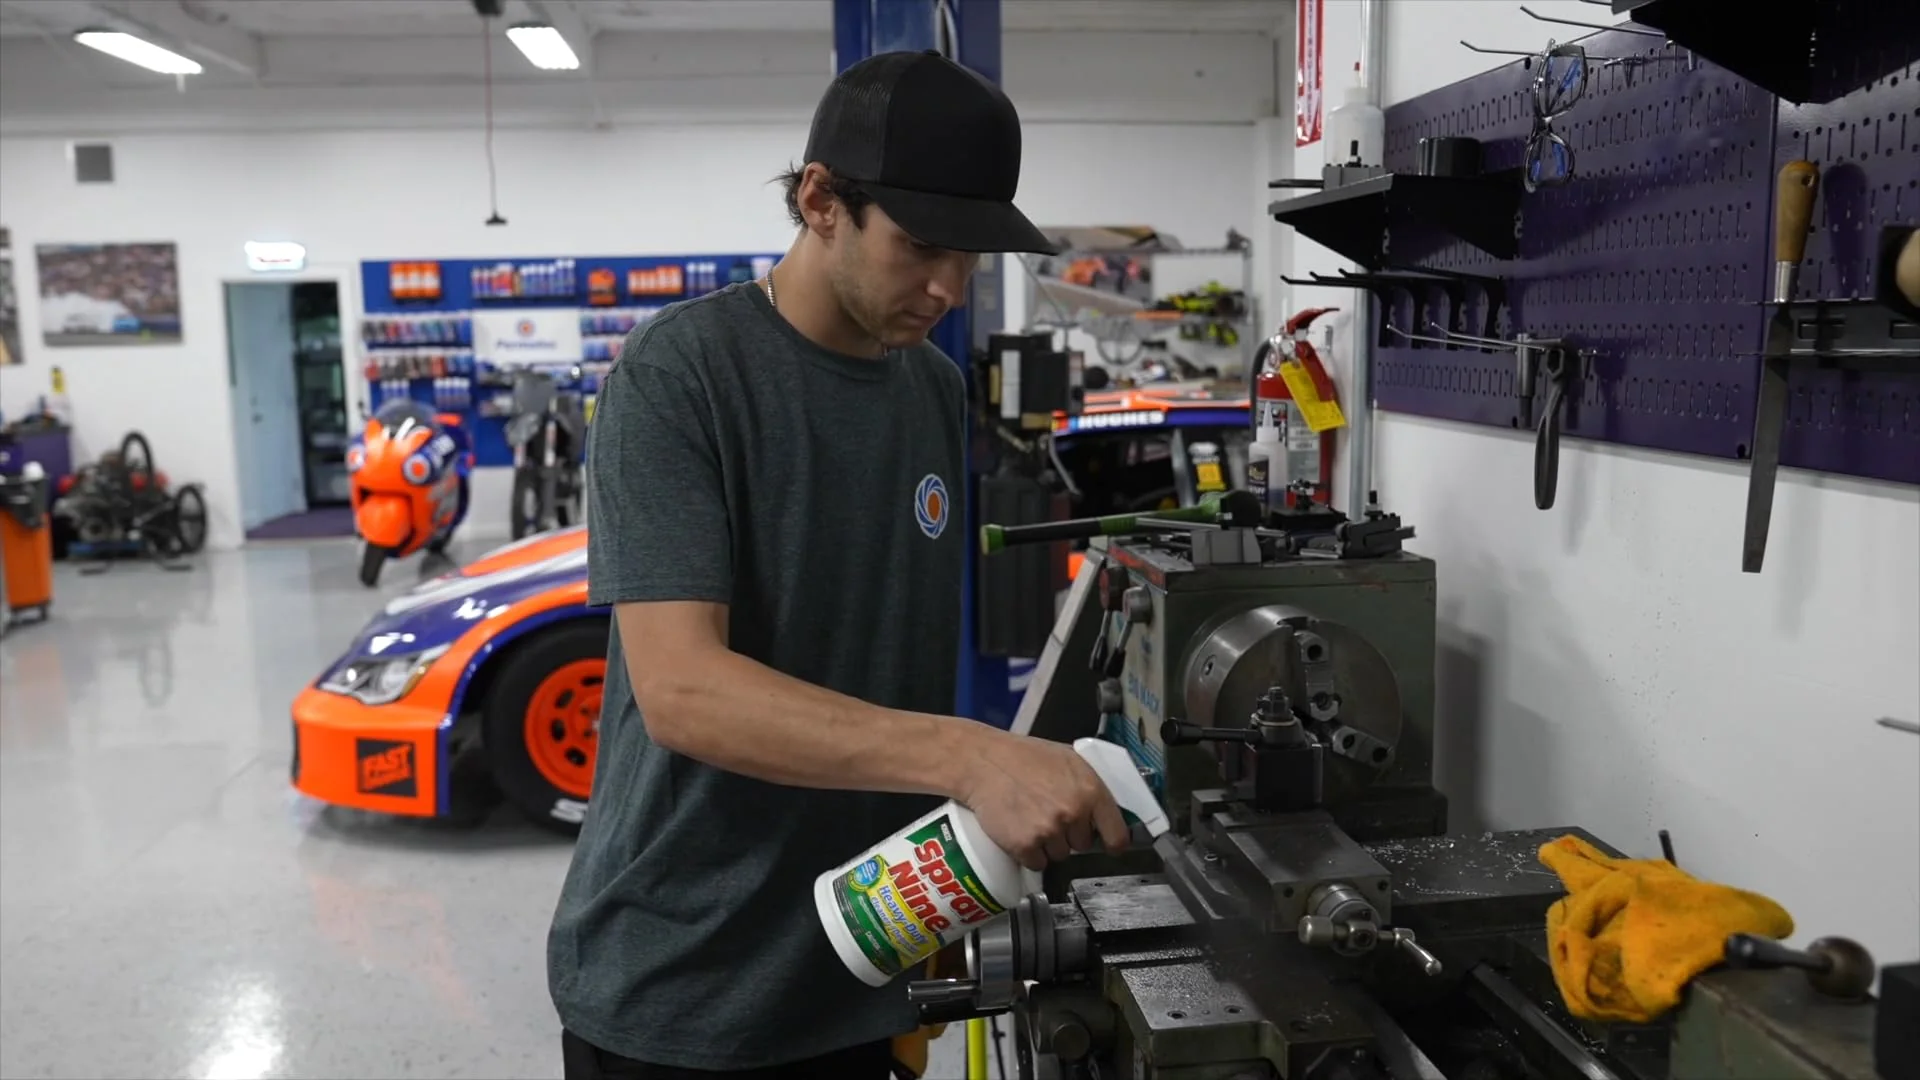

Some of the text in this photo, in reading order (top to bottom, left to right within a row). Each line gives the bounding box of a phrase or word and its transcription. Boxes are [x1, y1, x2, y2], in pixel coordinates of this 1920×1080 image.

[1079, 411, 1164, 429] HUGHES
[362, 744, 411, 776] FAST
[888, 861, 951, 932] Nine
[914, 839, 989, 924] Spray
